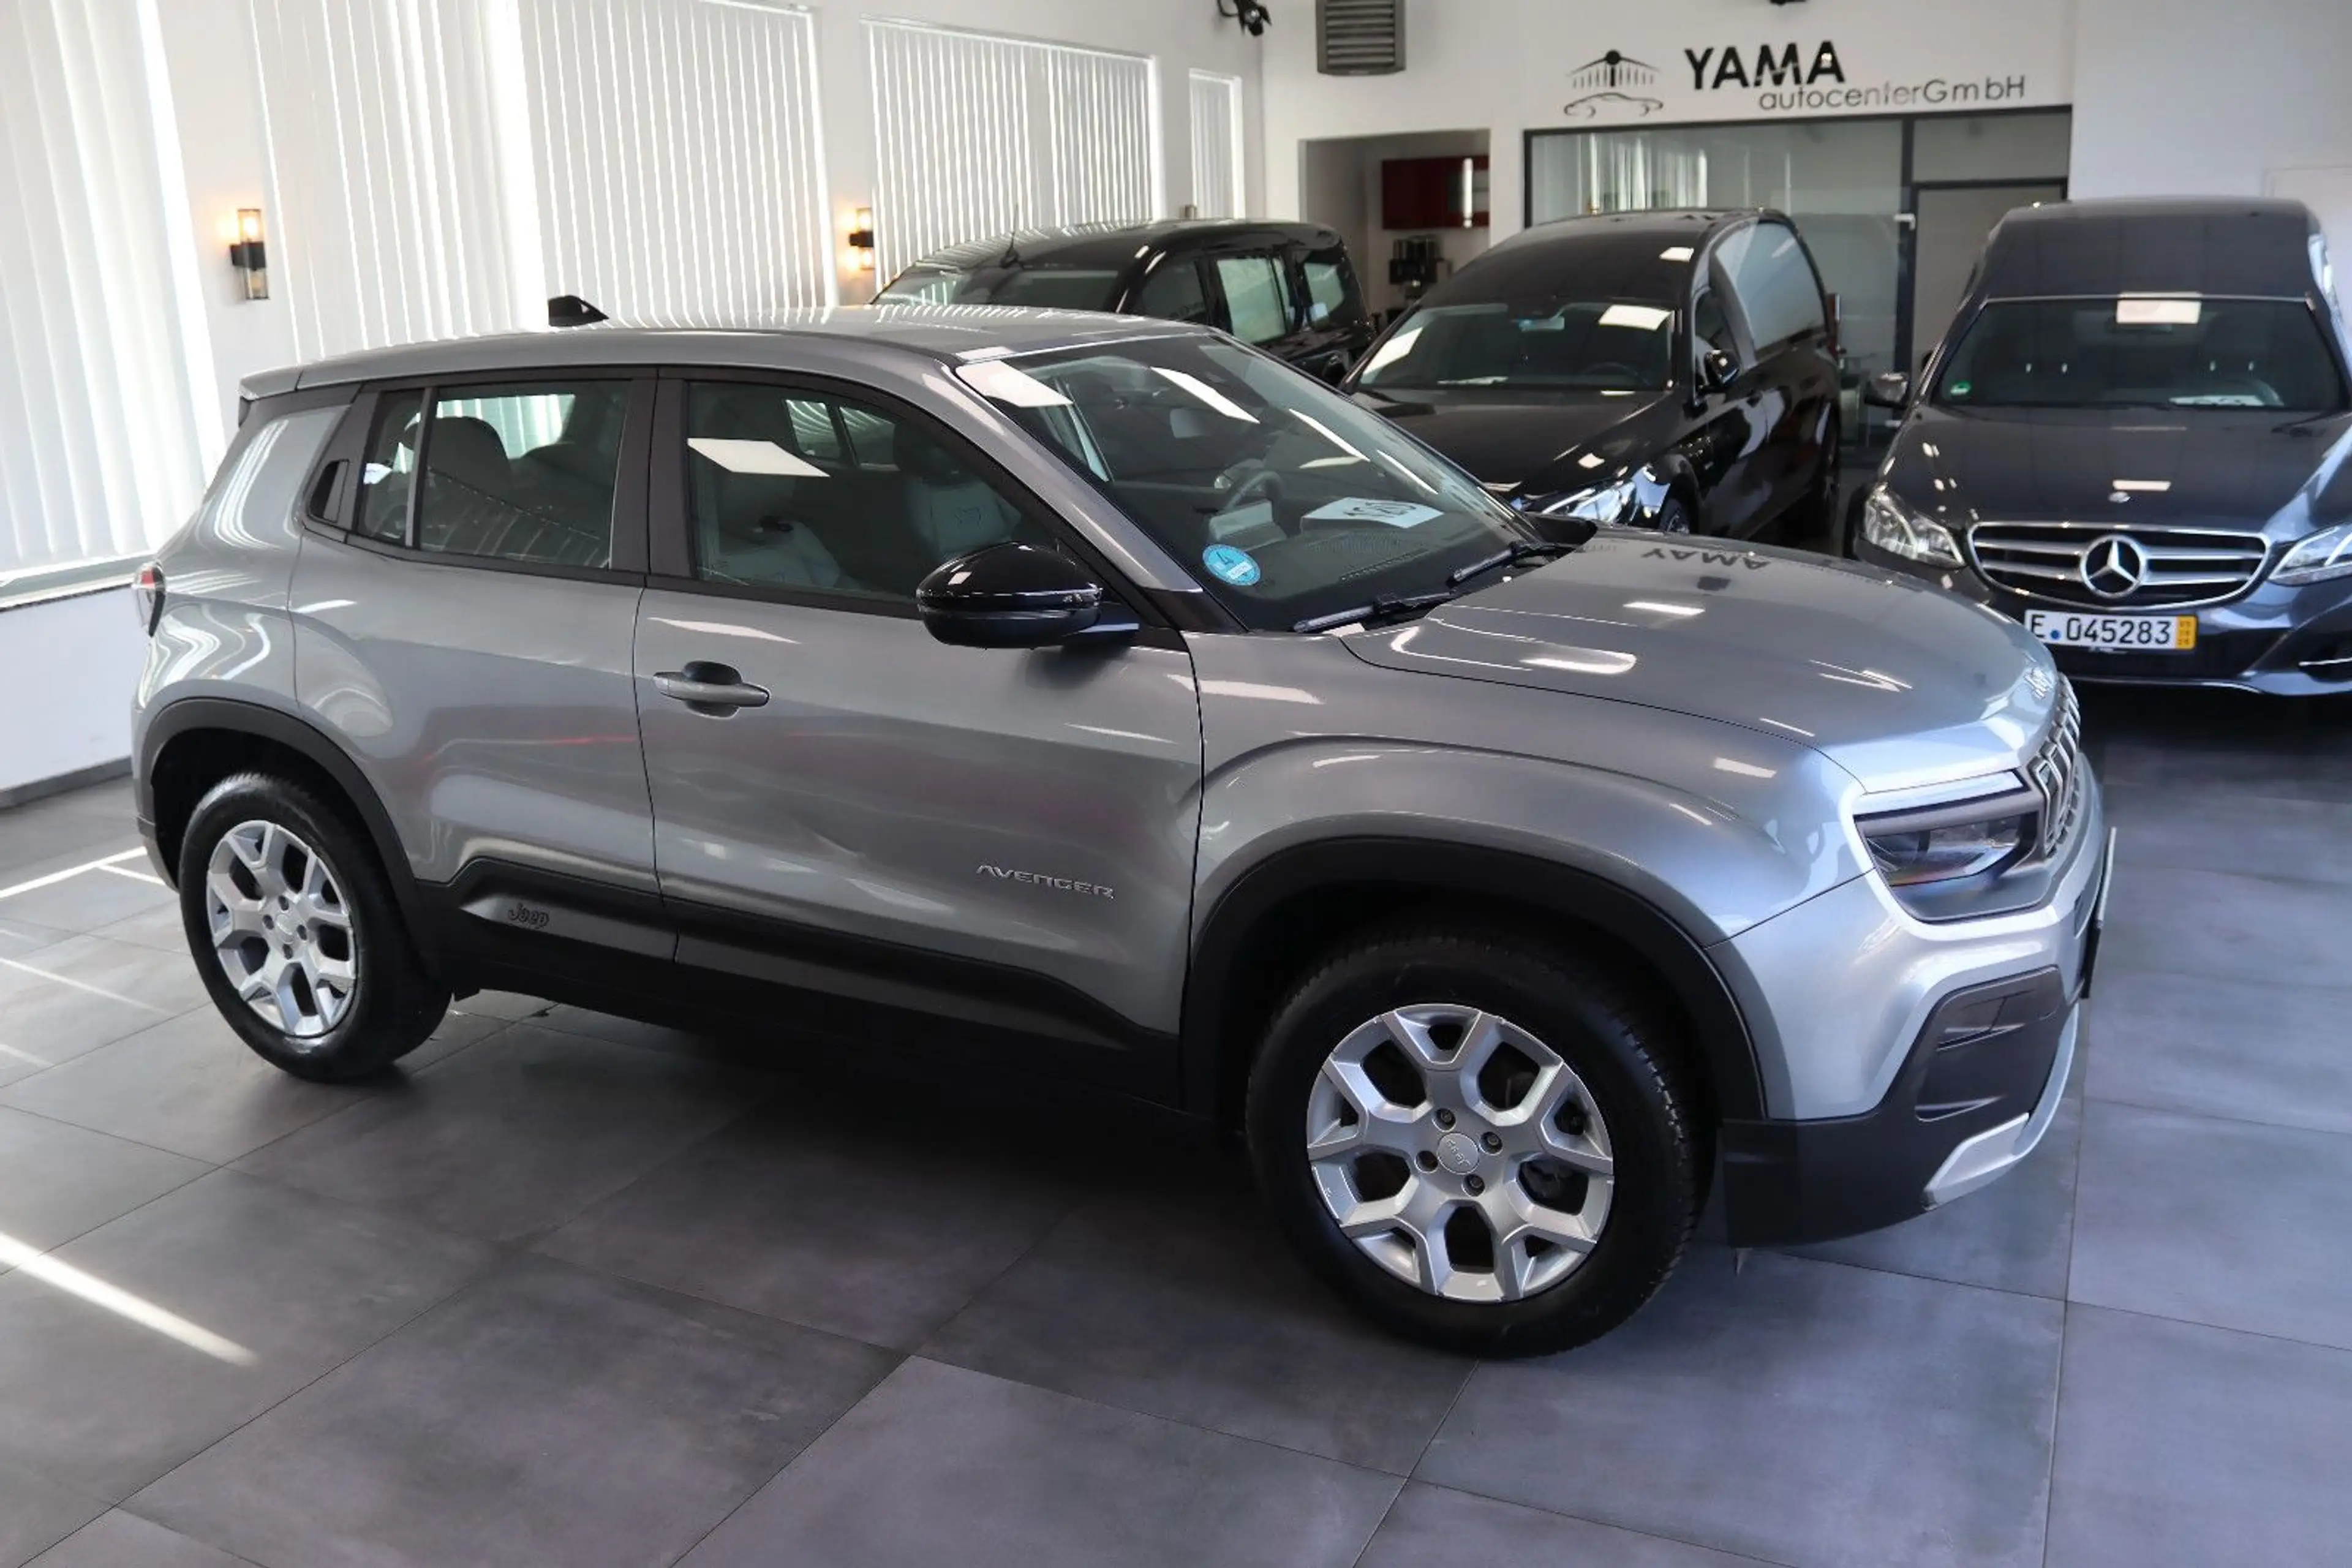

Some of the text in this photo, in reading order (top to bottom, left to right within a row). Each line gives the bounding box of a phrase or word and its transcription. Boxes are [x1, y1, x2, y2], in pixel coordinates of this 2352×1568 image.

[1684, 40, 1845, 90] YAMA
[2067, 617, 2170, 644] 045283
[976, 865, 1114, 899] AVENGER
[507, 902, 550, 929] Jeep
